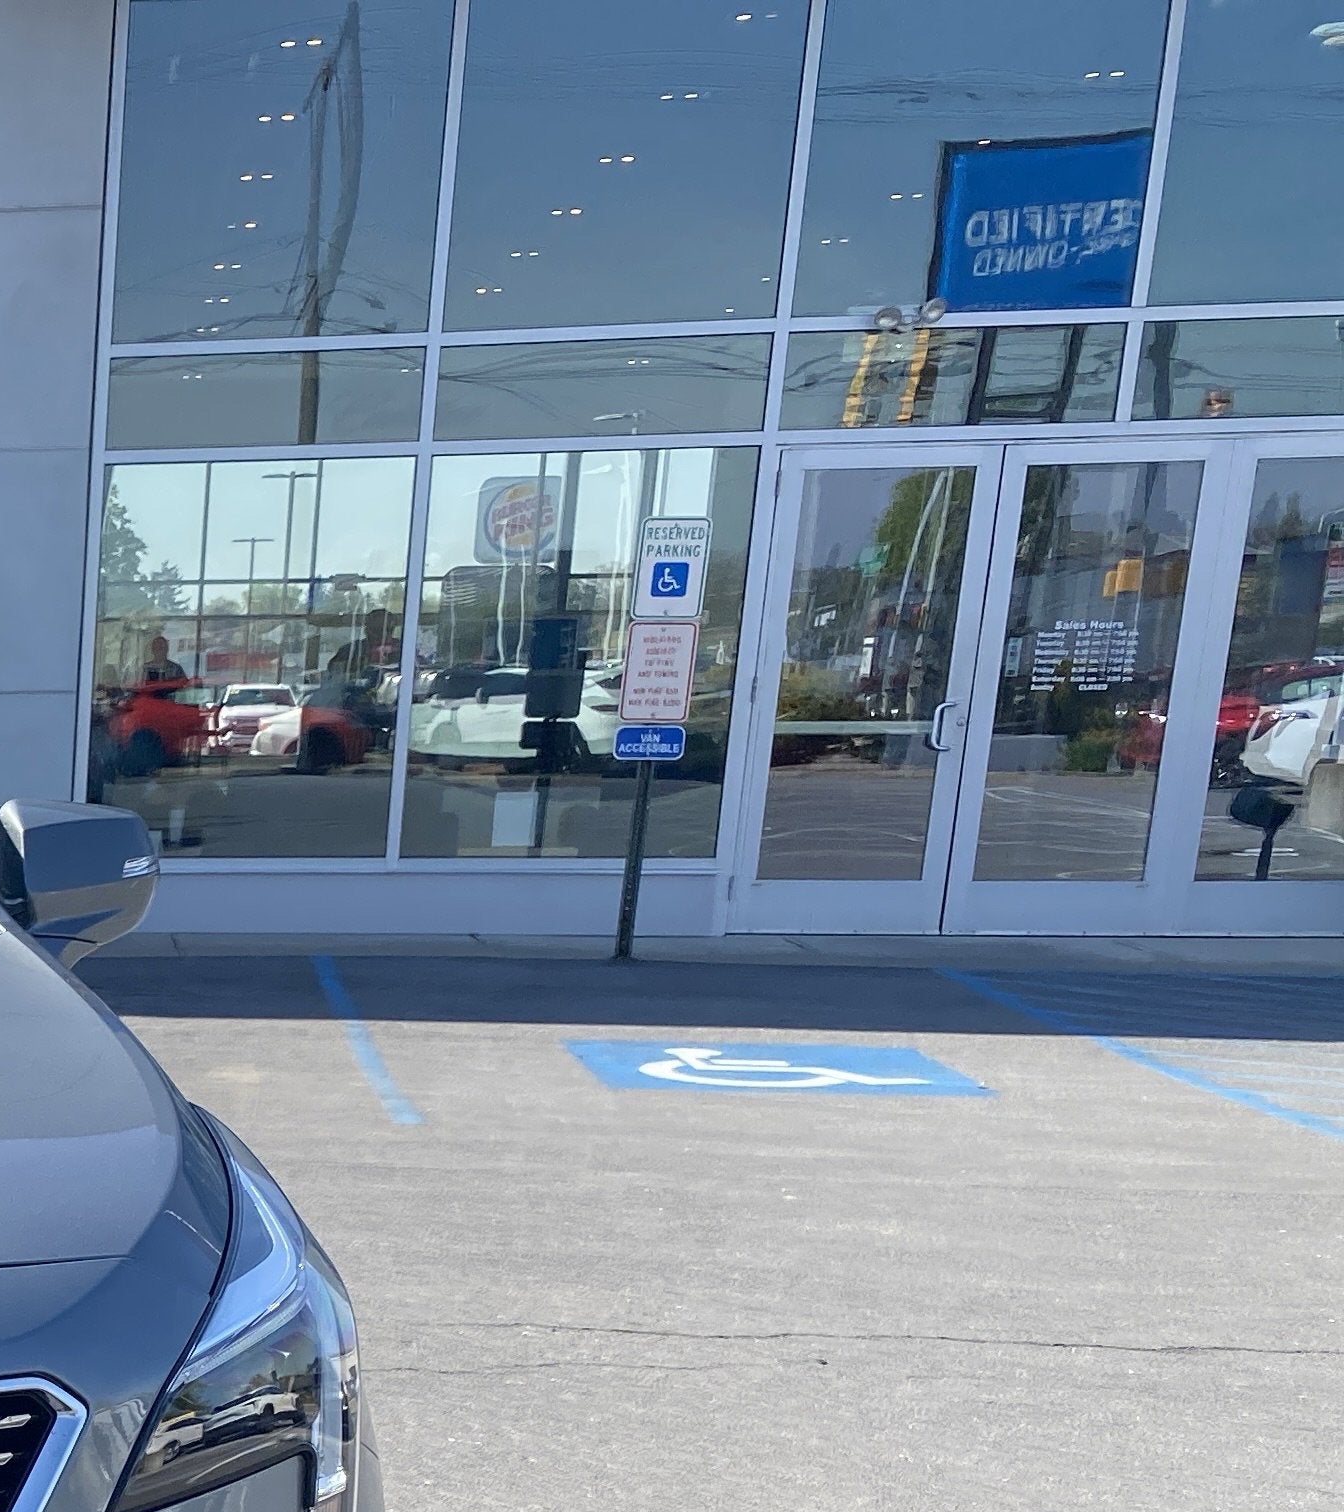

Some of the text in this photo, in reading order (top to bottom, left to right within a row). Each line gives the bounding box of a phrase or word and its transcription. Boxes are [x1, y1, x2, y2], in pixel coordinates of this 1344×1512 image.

[646, 526, 706, 540] RESERVED
[646, 544, 702, 558] PARKING
[1054, 620, 1124, 630] Sales Hours
[640, 733, 661, 743] VAN
